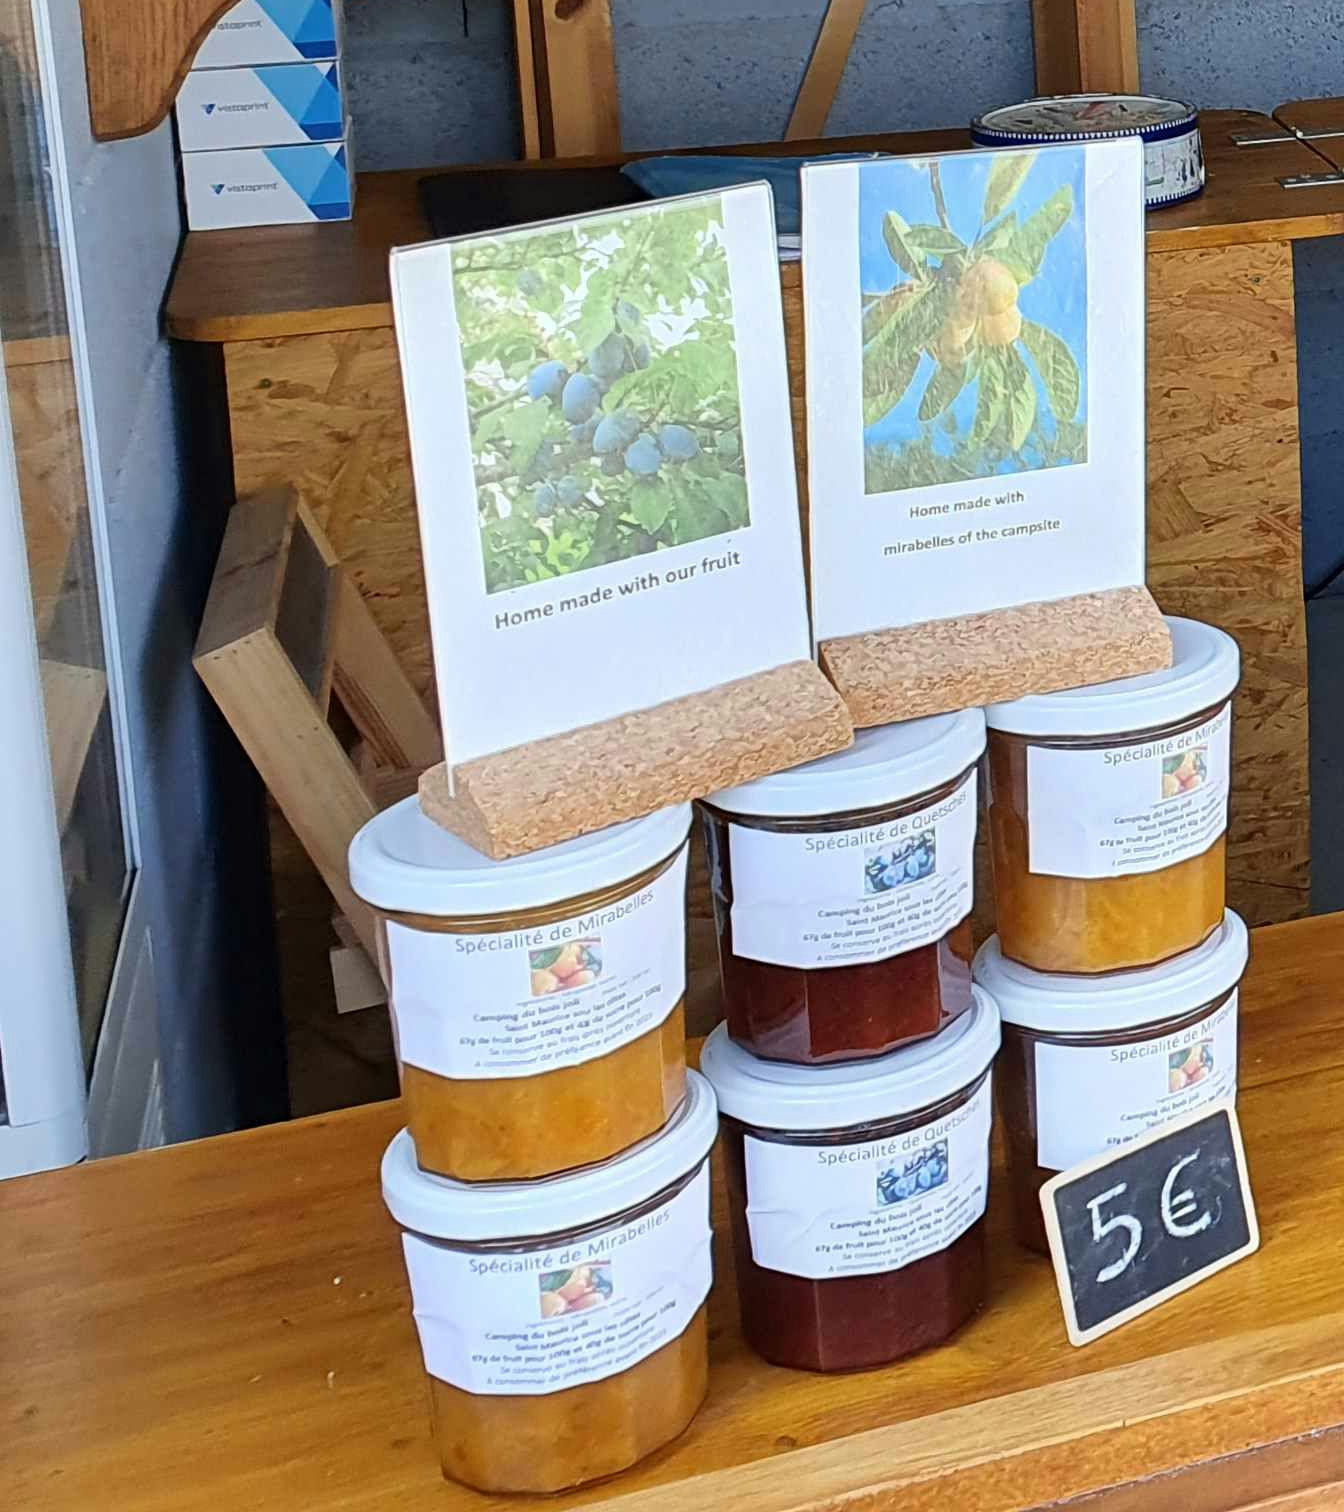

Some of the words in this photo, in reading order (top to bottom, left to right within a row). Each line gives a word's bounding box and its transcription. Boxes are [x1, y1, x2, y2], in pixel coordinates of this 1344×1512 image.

[217, 102, 270, 112] vistaprint
[227, 182, 278, 193] vistaprint
[909, 504, 949, 518] Home
[954, 496, 991, 511] made
[995, 490, 1025, 505] with
[884, 536, 955, 556] mirabelles
[958, 531, 973, 544] of
[976, 528, 998, 541] the
[1001, 519, 1061, 537] campsite
[494, 603, 554, 630] Home
[559, 587, 613, 613] made
[618, 572, 660, 596] with
[665, 563, 697, 584] our
[702, 551, 741, 574] fruit
[1103, 741, 1174, 766] Spécialité
[1177, 736, 1192, 750] de
[805, 830, 885, 853] Spécialité
[890, 823, 908, 837] de
[912, 791, 967, 829] Quetsches
[818, 909, 860, 918] Camping
[863, 904, 875, 913] du
[877, 899, 895, 910] bois
[897, 893, 911, 906] joli
[456, 932, 544, 954] Spécialité
[549, 926, 573, 942] de
[578, 890, 654, 934] Mirabelles
[473, 1012, 518, 1023] Camping
[521, 1007, 536, 1019] du
[538, 1003, 561, 1014] bois
[504, 1022, 528, 1032] Saint
[1110, 1038, 1180, 1063] Spécialité
[1183, 1031, 1198, 1043] de
[1120, 1110, 1158, 1121] Camping
[818, 1144, 896, 1166] Spécialité
[902, 1136, 920, 1150] de
[830, 1220, 871, 1230] Camping
[874, 1216, 886, 1225] du
[888, 1211, 907, 1221] bois
[469, 1255, 553, 1275] Spécialité
[559, 1250, 581, 1264] de
[588, 1210, 670, 1257] Mirabelles
[485, 1332, 529, 1341] Camping
[531, 1331, 544, 1339] du
[547, 1326, 569, 1336] bois
